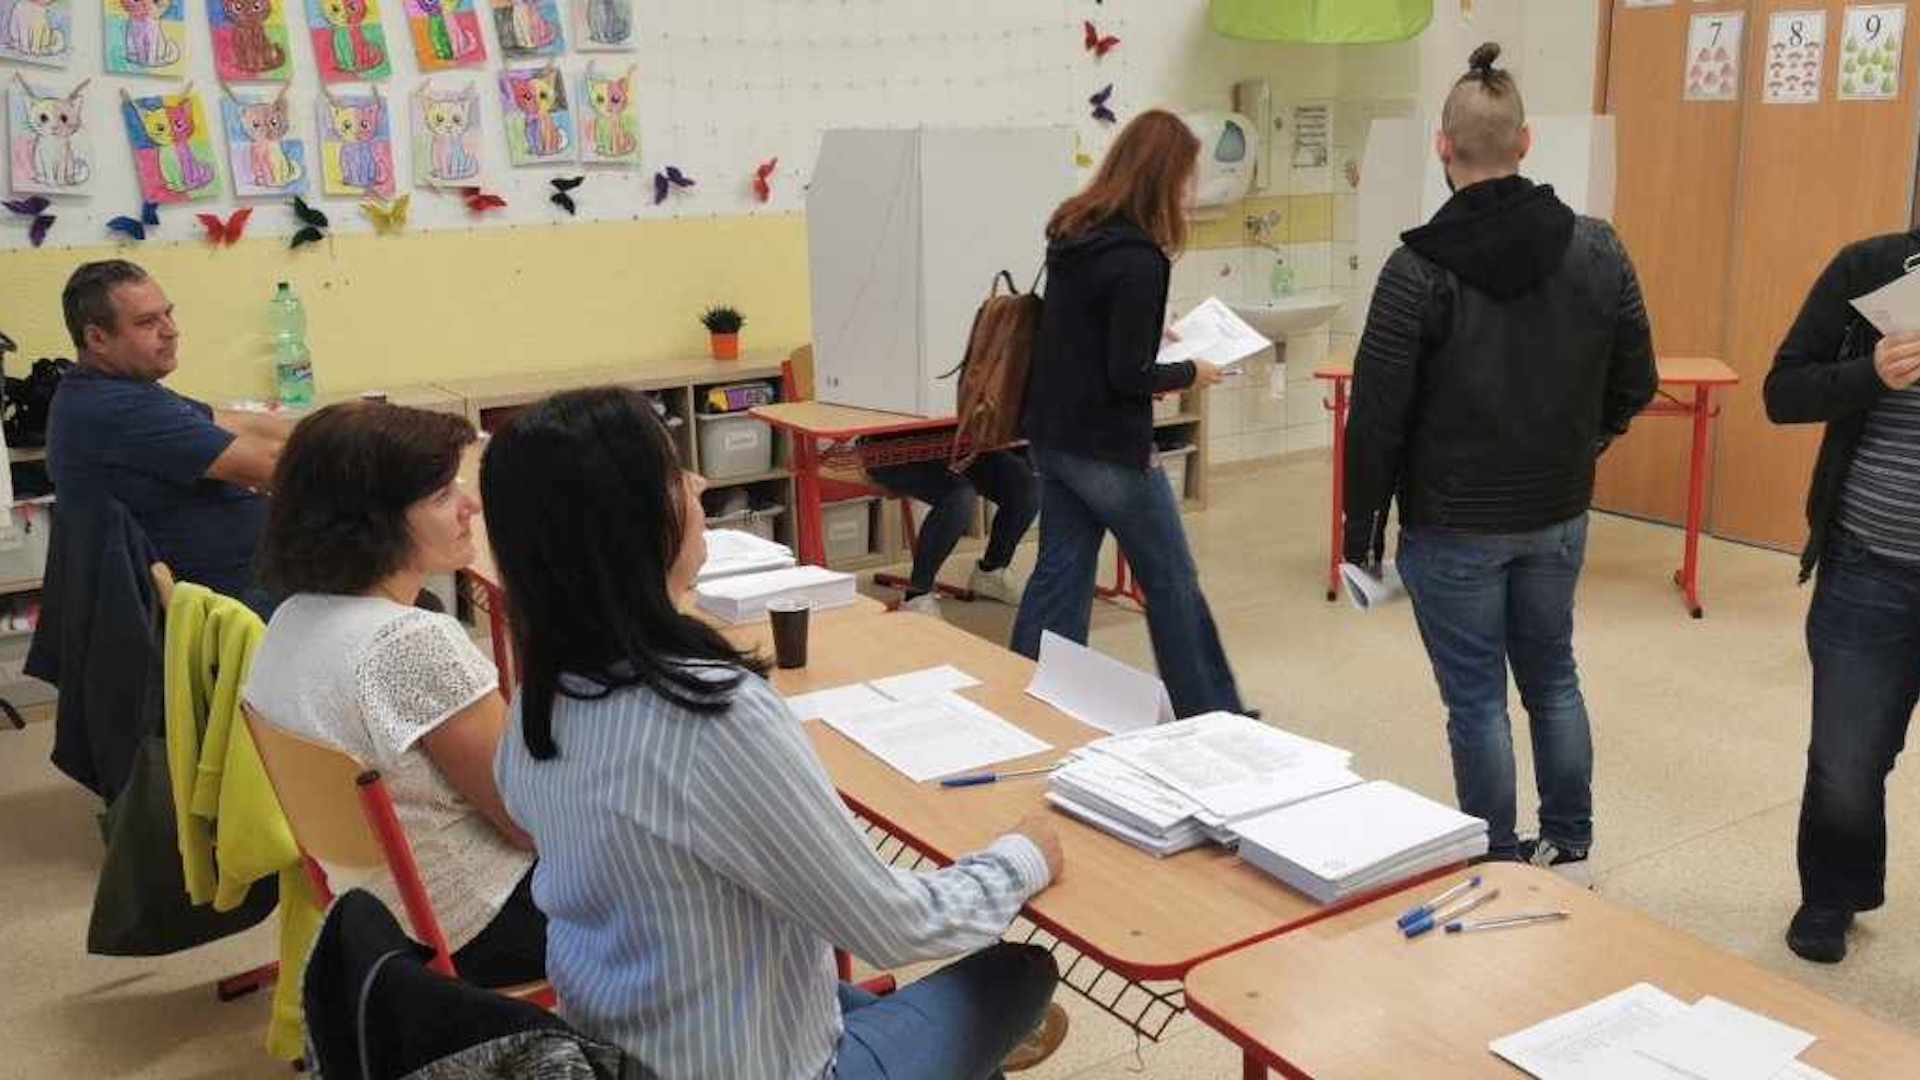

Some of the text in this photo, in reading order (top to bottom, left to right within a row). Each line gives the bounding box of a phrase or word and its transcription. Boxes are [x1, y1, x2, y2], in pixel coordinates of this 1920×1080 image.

[1710, 21, 1723, 47] 7
[1790, 20, 1804, 48] 8
[1866, 15, 1881, 41] 9
